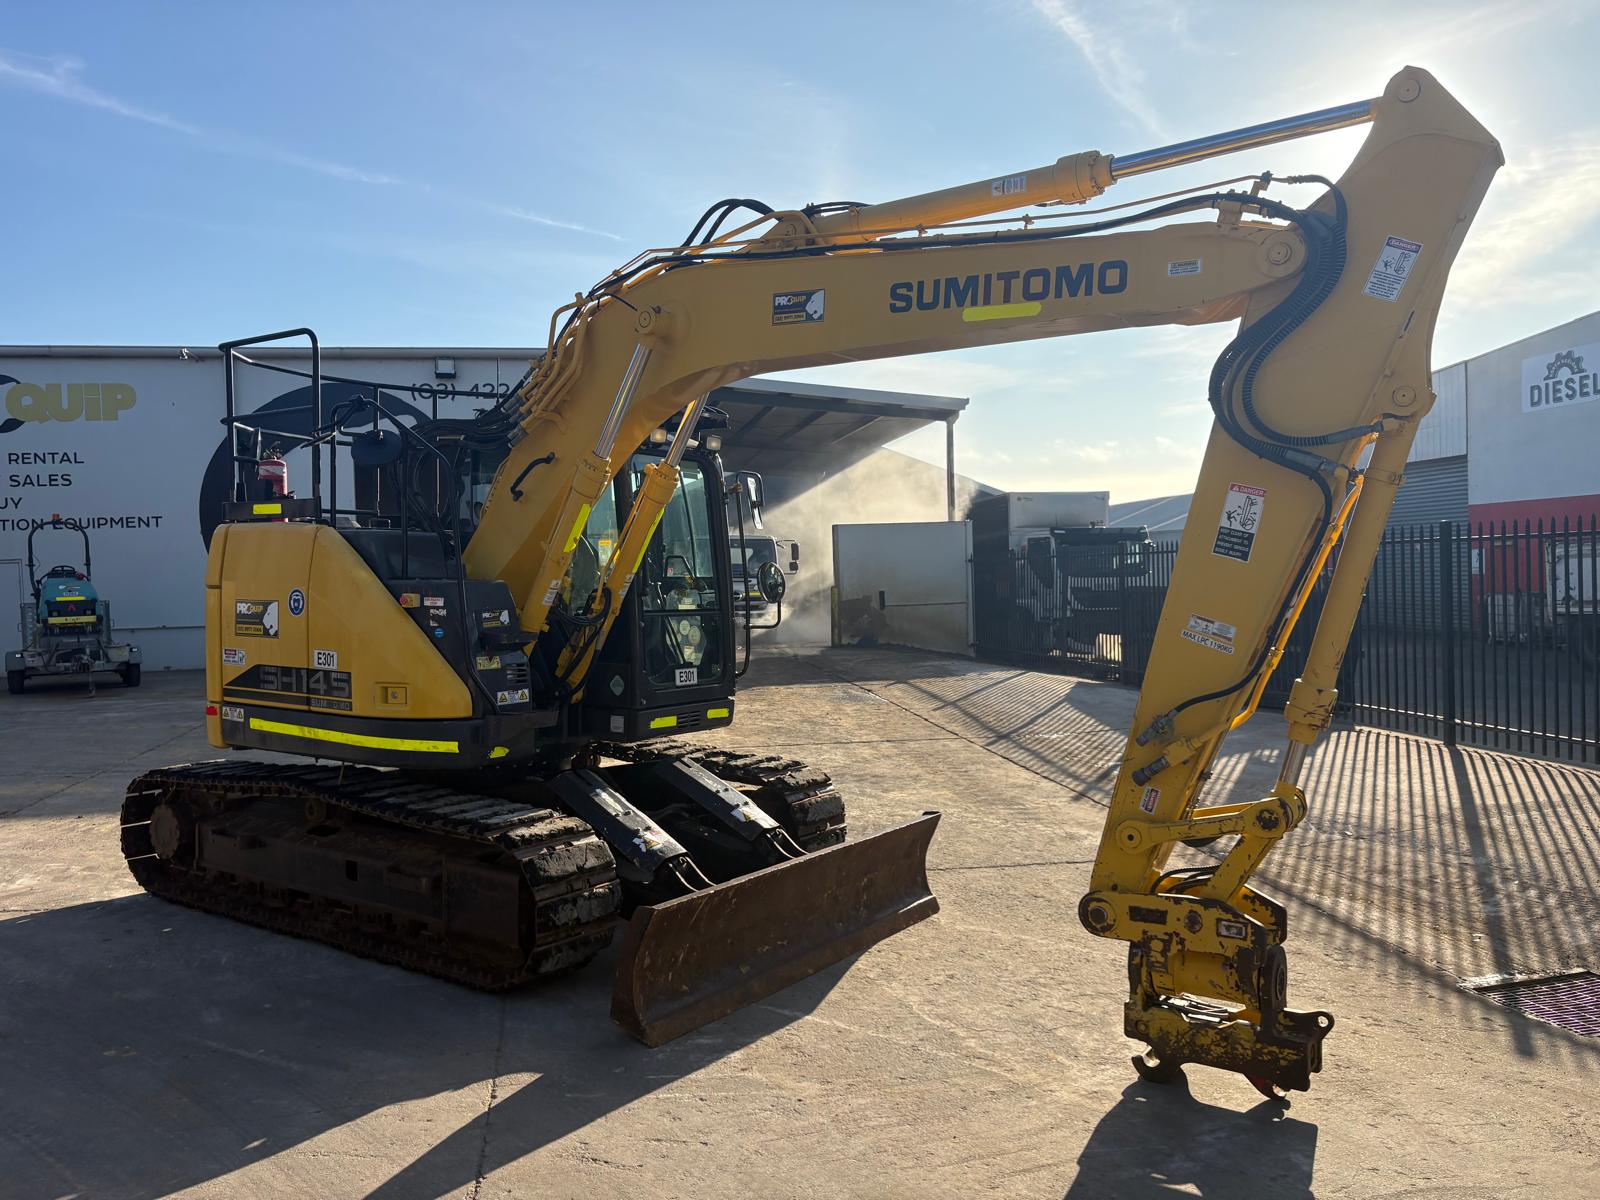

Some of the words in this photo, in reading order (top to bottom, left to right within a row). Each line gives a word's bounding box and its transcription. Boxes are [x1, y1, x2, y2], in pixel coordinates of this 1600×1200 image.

[889, 259, 1128, 314] SUMITOMO
[1529, 372, 1600, 408] DIESEL
[8, 452, 84, 465] RENTAL
[9, 473, 73, 487] SALES
[1240, 486, 1264, 496] DANGER
[52, 516, 163, 531] EQUIPMENT
[1183, 630, 1197, 641] MAX
[1197, 634, 1210, 646] LPC
[317, 652, 335, 667] E301
[260, 666, 350, 698] SH145
[679, 671, 694, 682] E301
